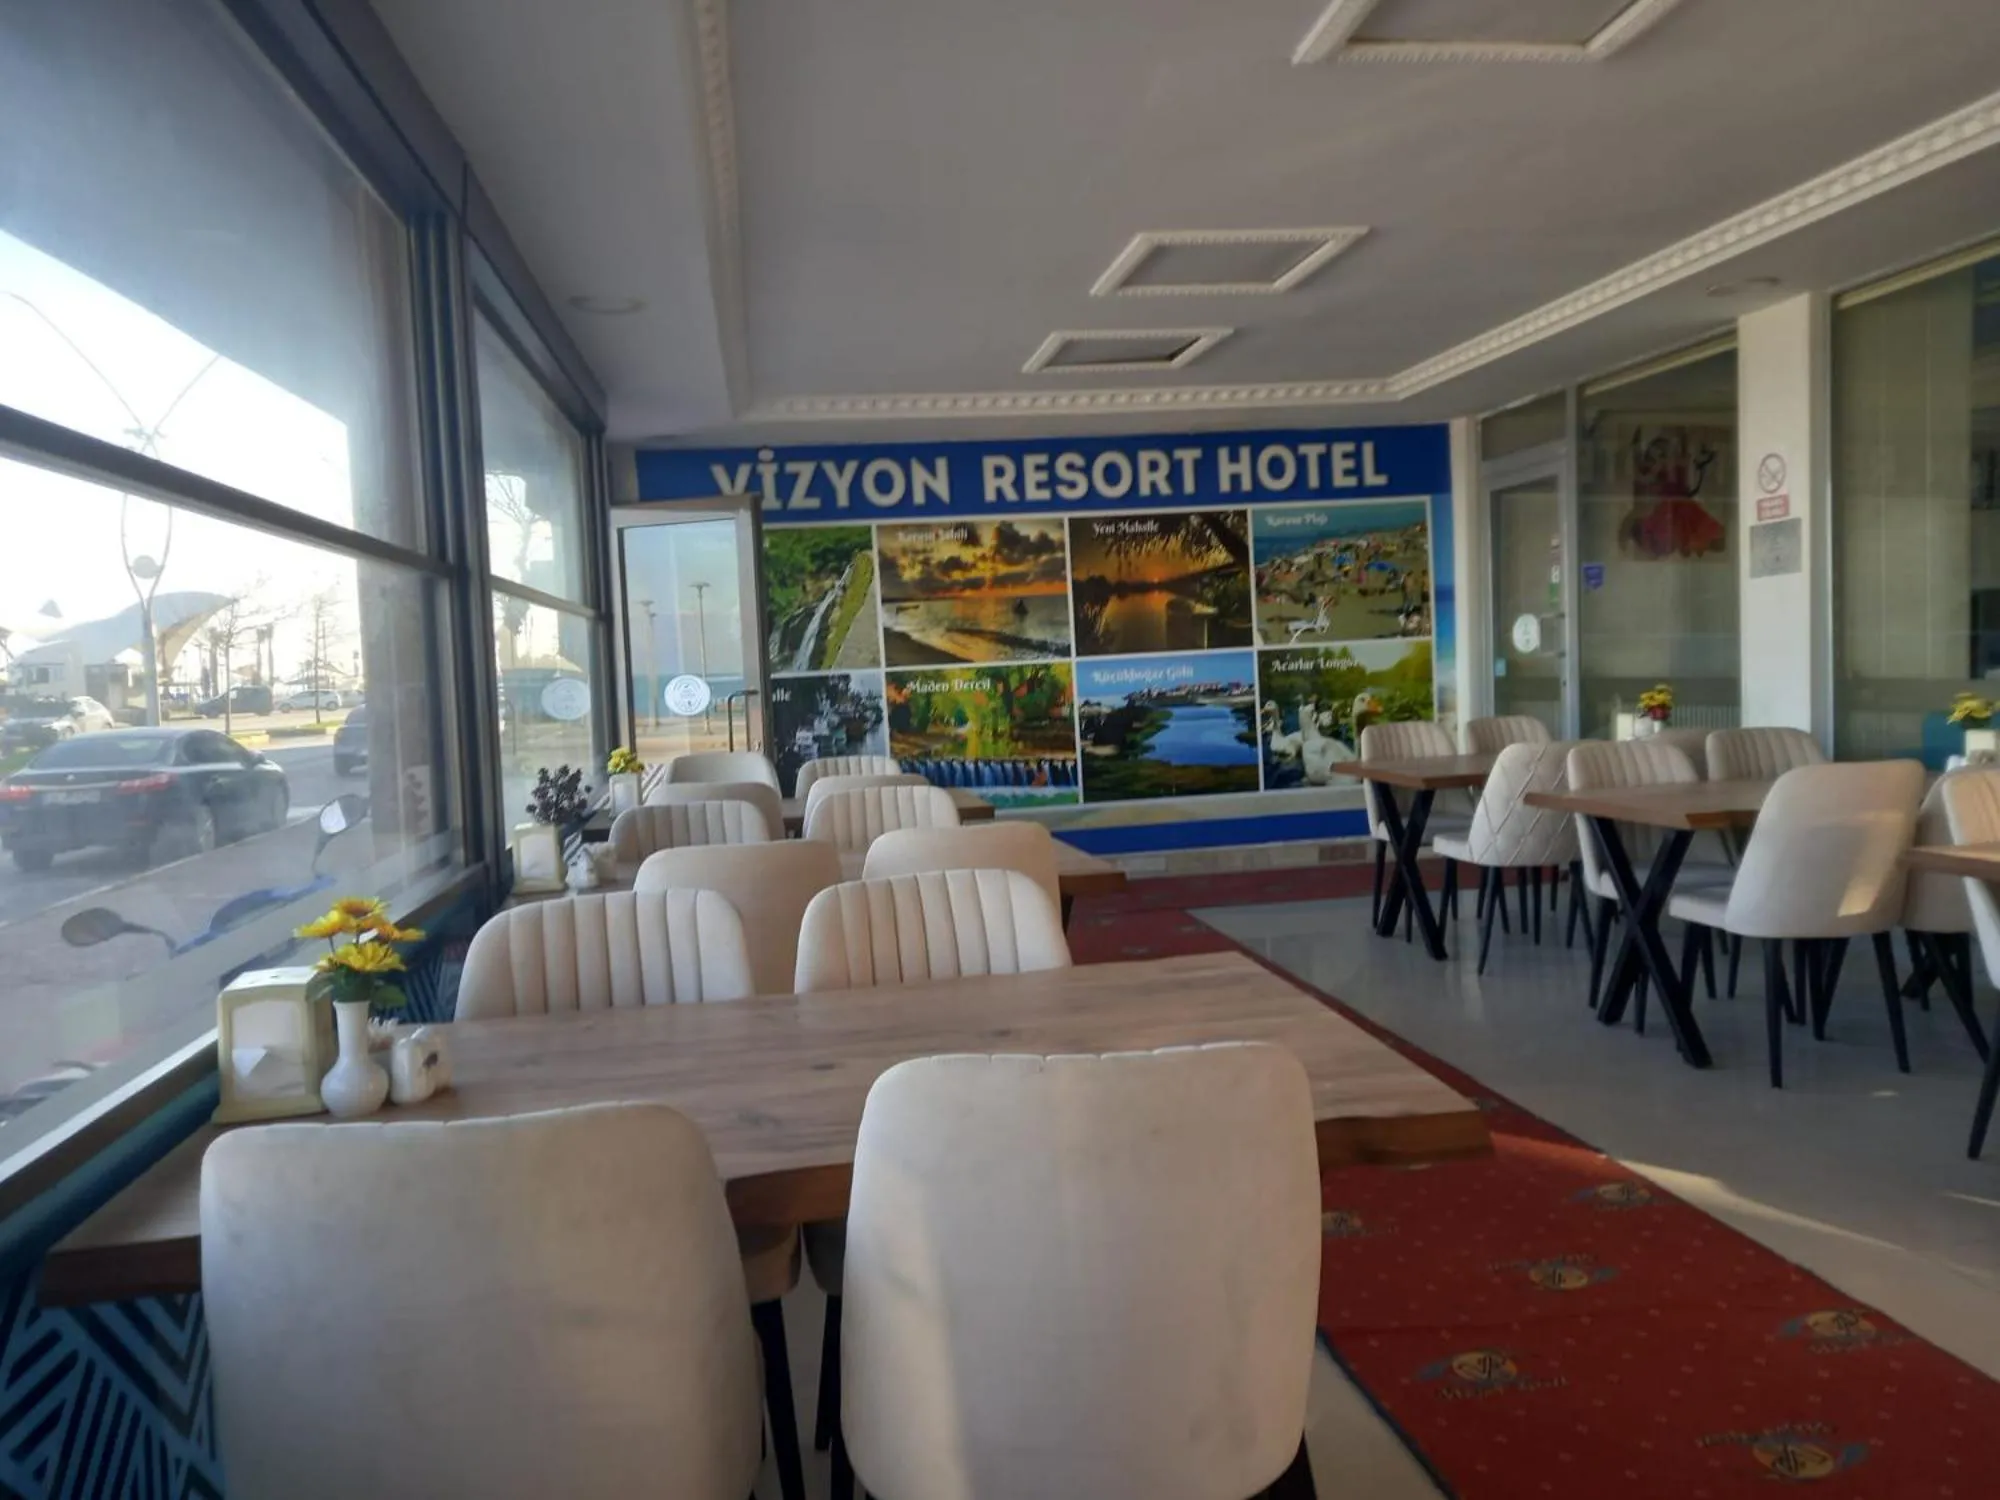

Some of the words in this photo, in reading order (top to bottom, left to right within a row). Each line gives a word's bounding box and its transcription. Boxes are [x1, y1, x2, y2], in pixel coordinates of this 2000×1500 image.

[710, 448, 951, 510] VİZYON
[982, 446, 1203, 504] RESORT
[1217, 440, 1389, 494] HOTEL
